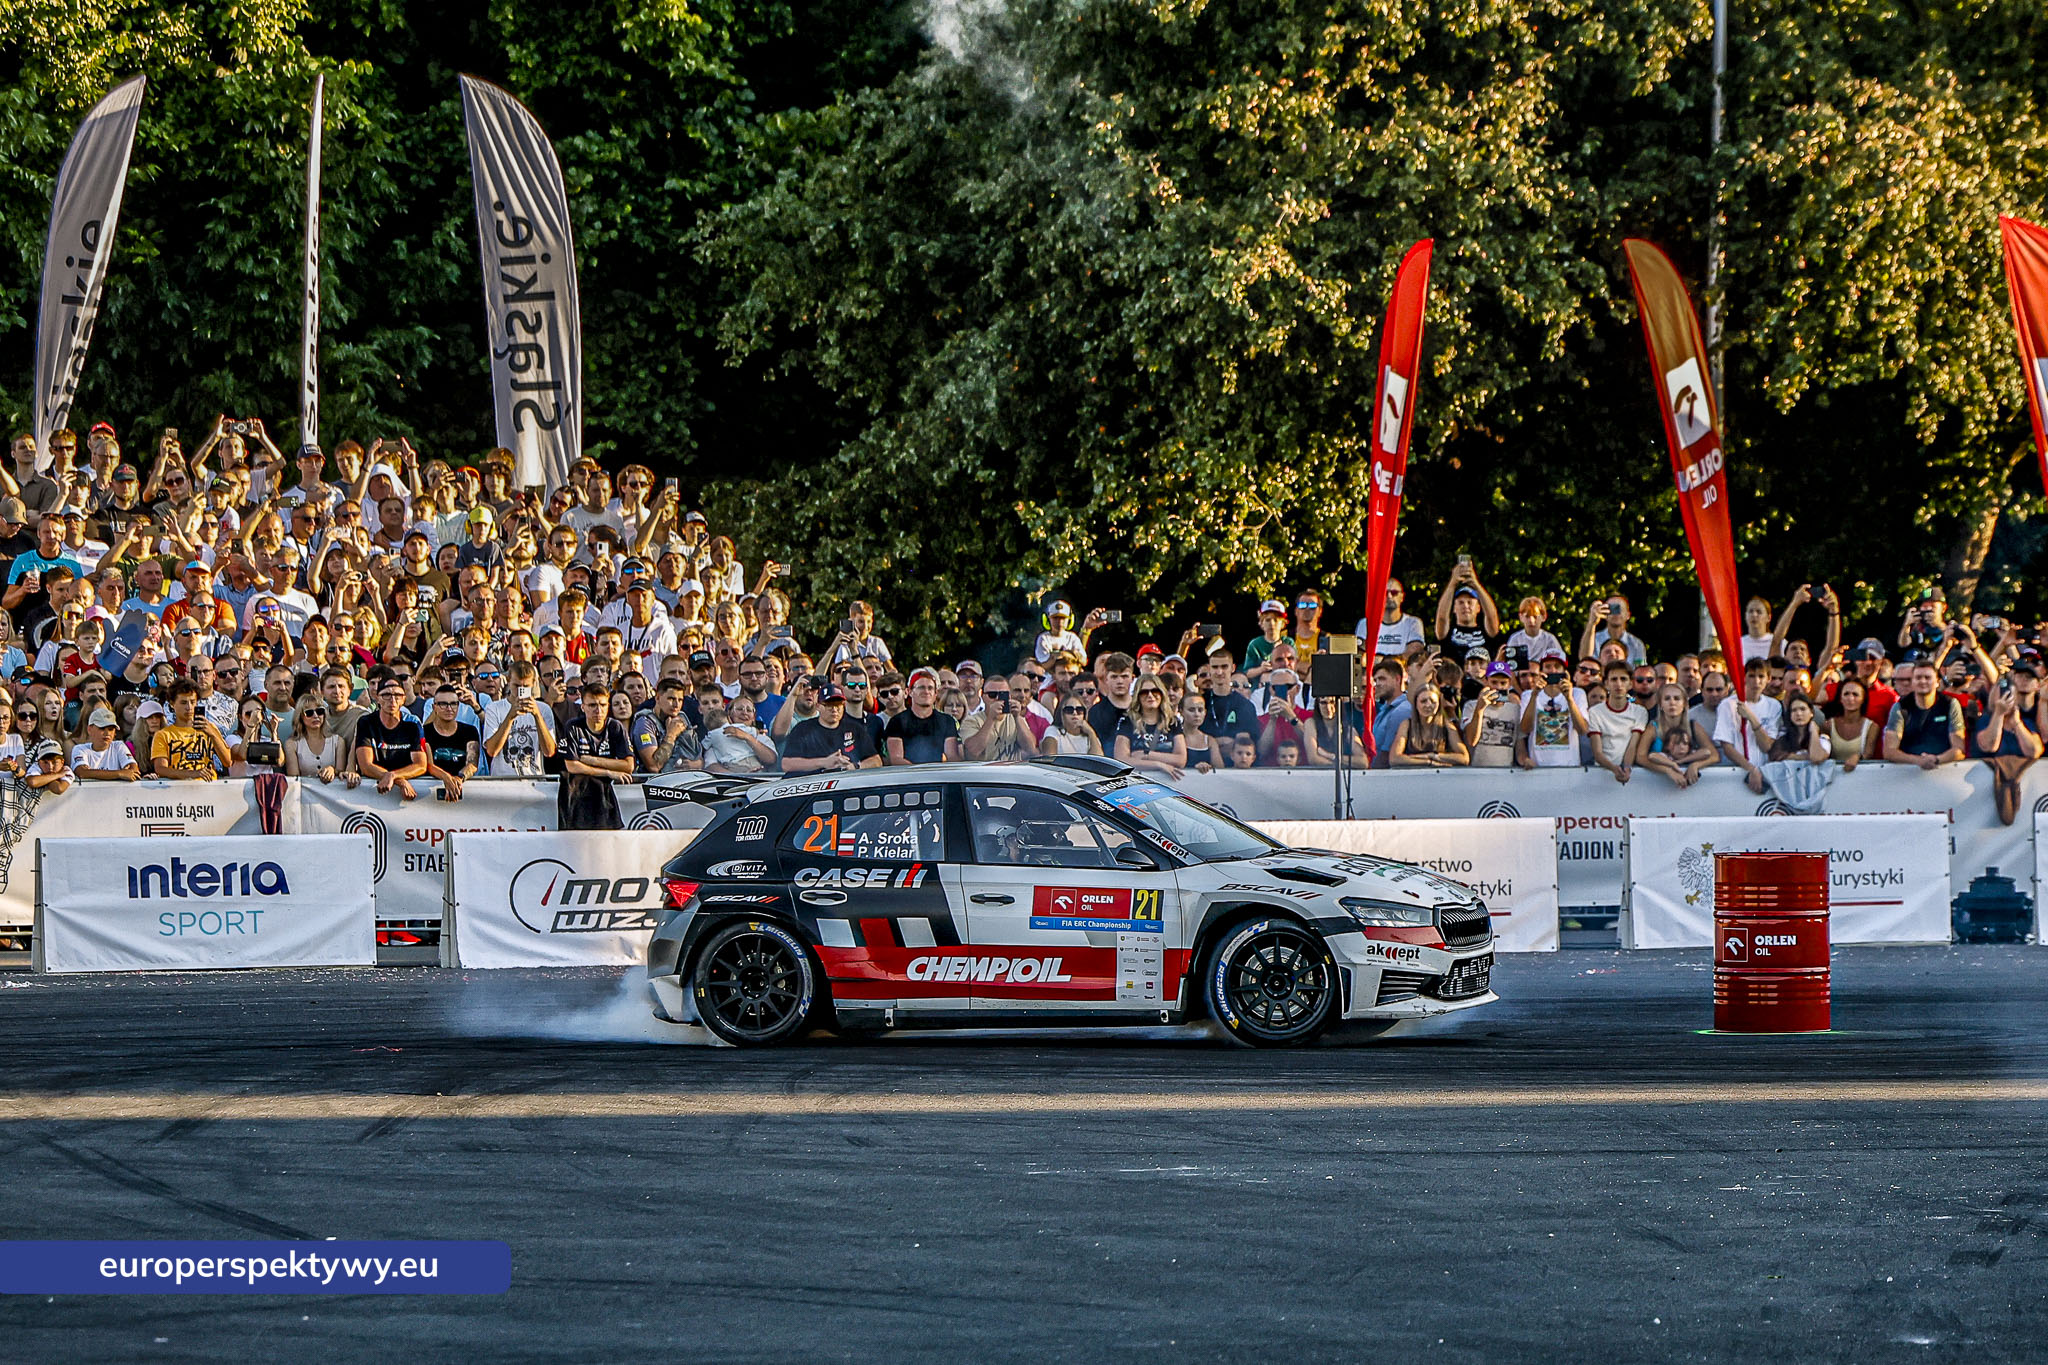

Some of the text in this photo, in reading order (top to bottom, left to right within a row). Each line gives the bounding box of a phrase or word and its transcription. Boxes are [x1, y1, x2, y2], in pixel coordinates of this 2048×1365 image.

[773, 782, 820, 797] CASE
[126, 803, 215, 822] STADION ŚLĄSKI
[803, 814, 838, 852] 21
[858, 832, 918, 845] A. Sroka
[858, 846, 915, 859] P. Kielar
[1557, 841, 1614, 860] ADION
[128, 857, 290, 898] interia
[793, 867, 893, 888] CASE
[1081, 894, 1114, 904] ORLEN
[1134, 889, 1158, 920] 21
[159, 910, 264, 936] SPORT
[1088, 920, 1132, 930] Championship
[764, 924, 804, 957] MICHELIN
[1754, 935, 1797, 946] ORLEN
[1754, 947, 1771, 957] OIL
[1215, 965, 1230, 1013] MICHELIN
